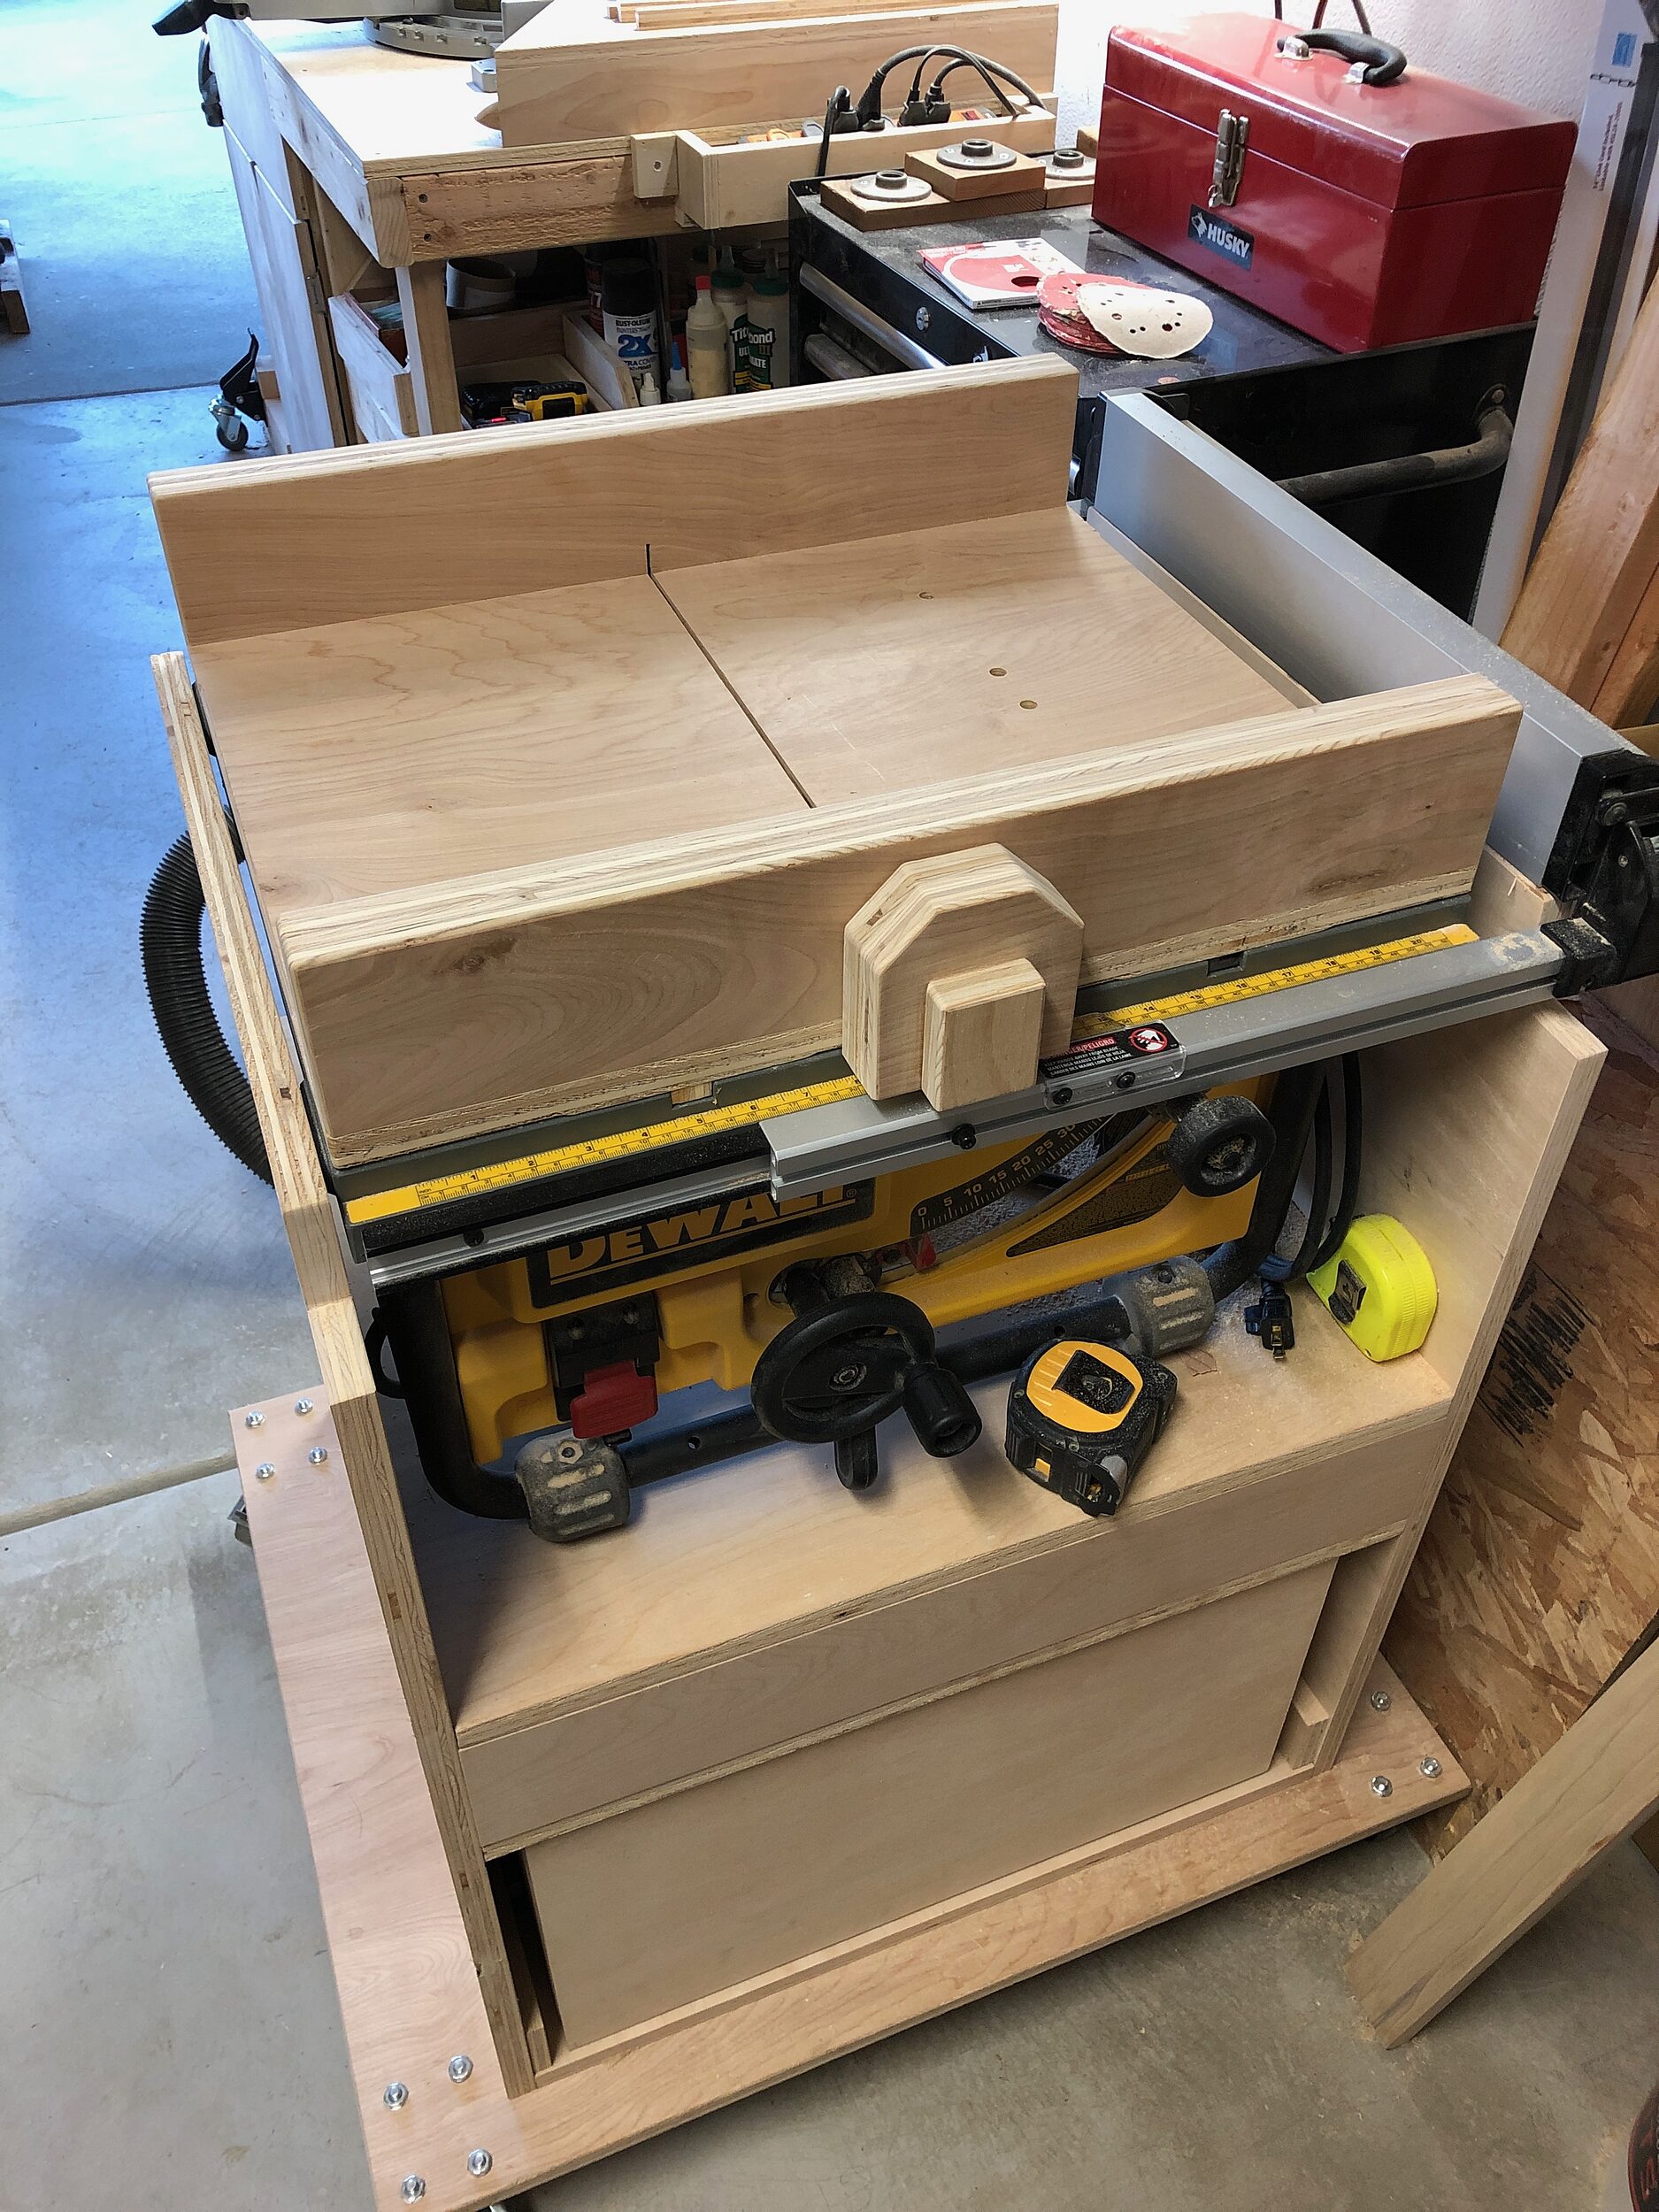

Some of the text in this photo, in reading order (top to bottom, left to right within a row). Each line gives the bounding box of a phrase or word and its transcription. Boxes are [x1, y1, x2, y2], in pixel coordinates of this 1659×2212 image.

[1208, 223, 1250, 258] HUSKY
[618, 334, 651, 357] 2X
[918, 1124, 1076, 1217] 0 5 10 15 20 25 30
